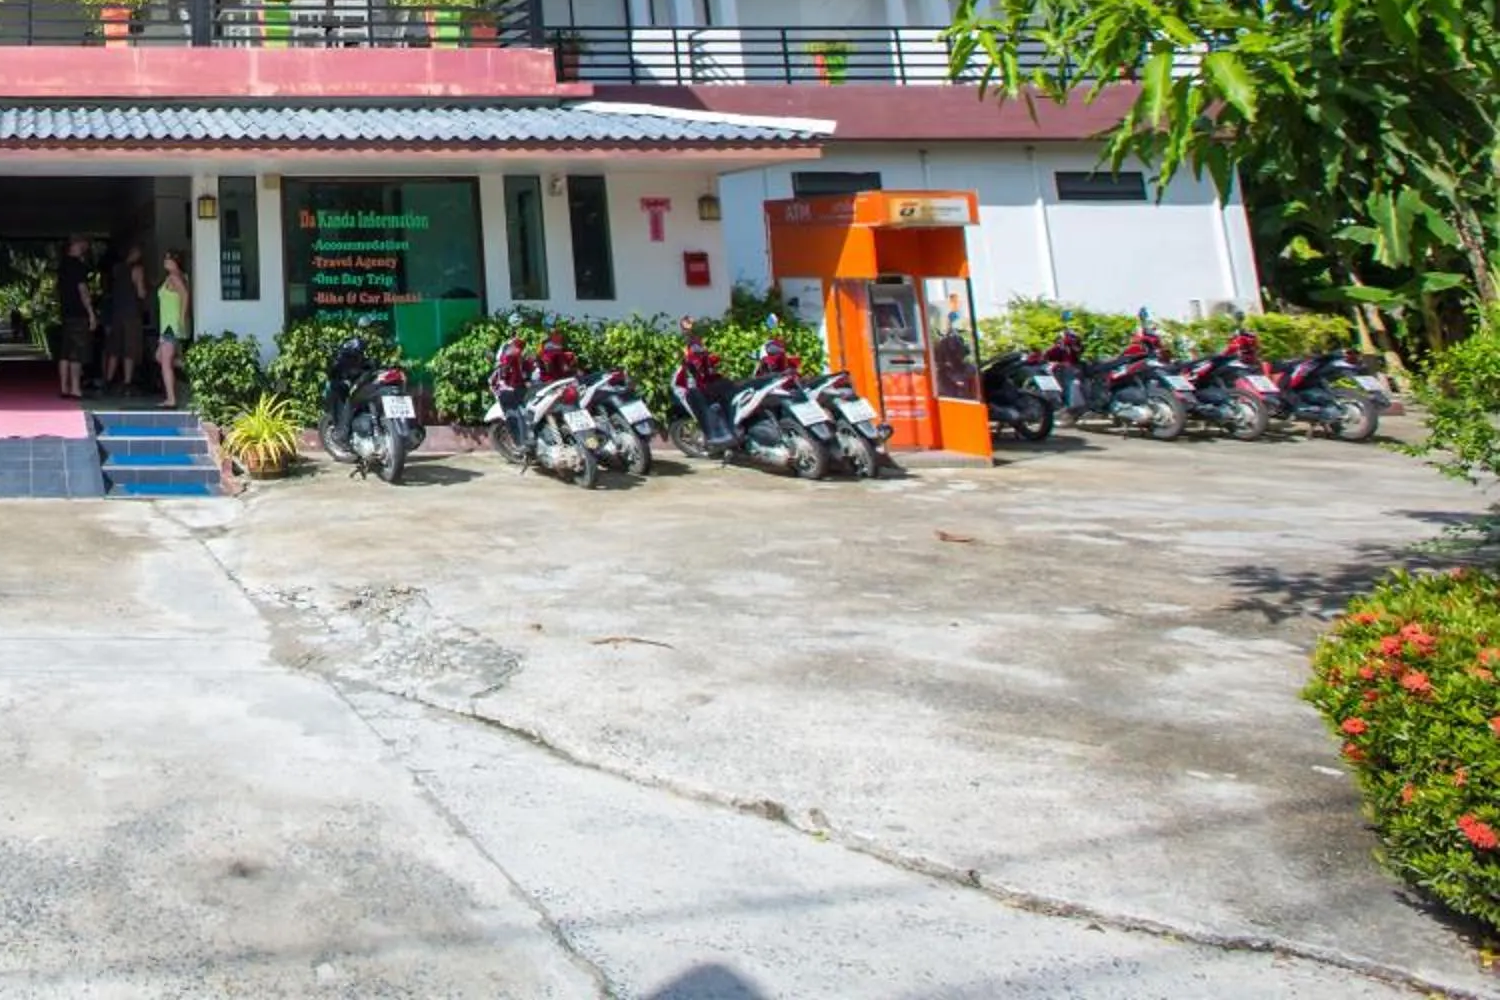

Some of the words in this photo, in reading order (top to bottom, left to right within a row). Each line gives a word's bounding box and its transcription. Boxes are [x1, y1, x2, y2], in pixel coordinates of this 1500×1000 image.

[317, 209, 355, 228] Kanda
[357, 209, 429, 229] Information
[355, 256, 397, 269] Agency
[341, 273, 363, 287] Day
[366, 273, 393, 287] Trip
[359, 292, 381, 304] Car
